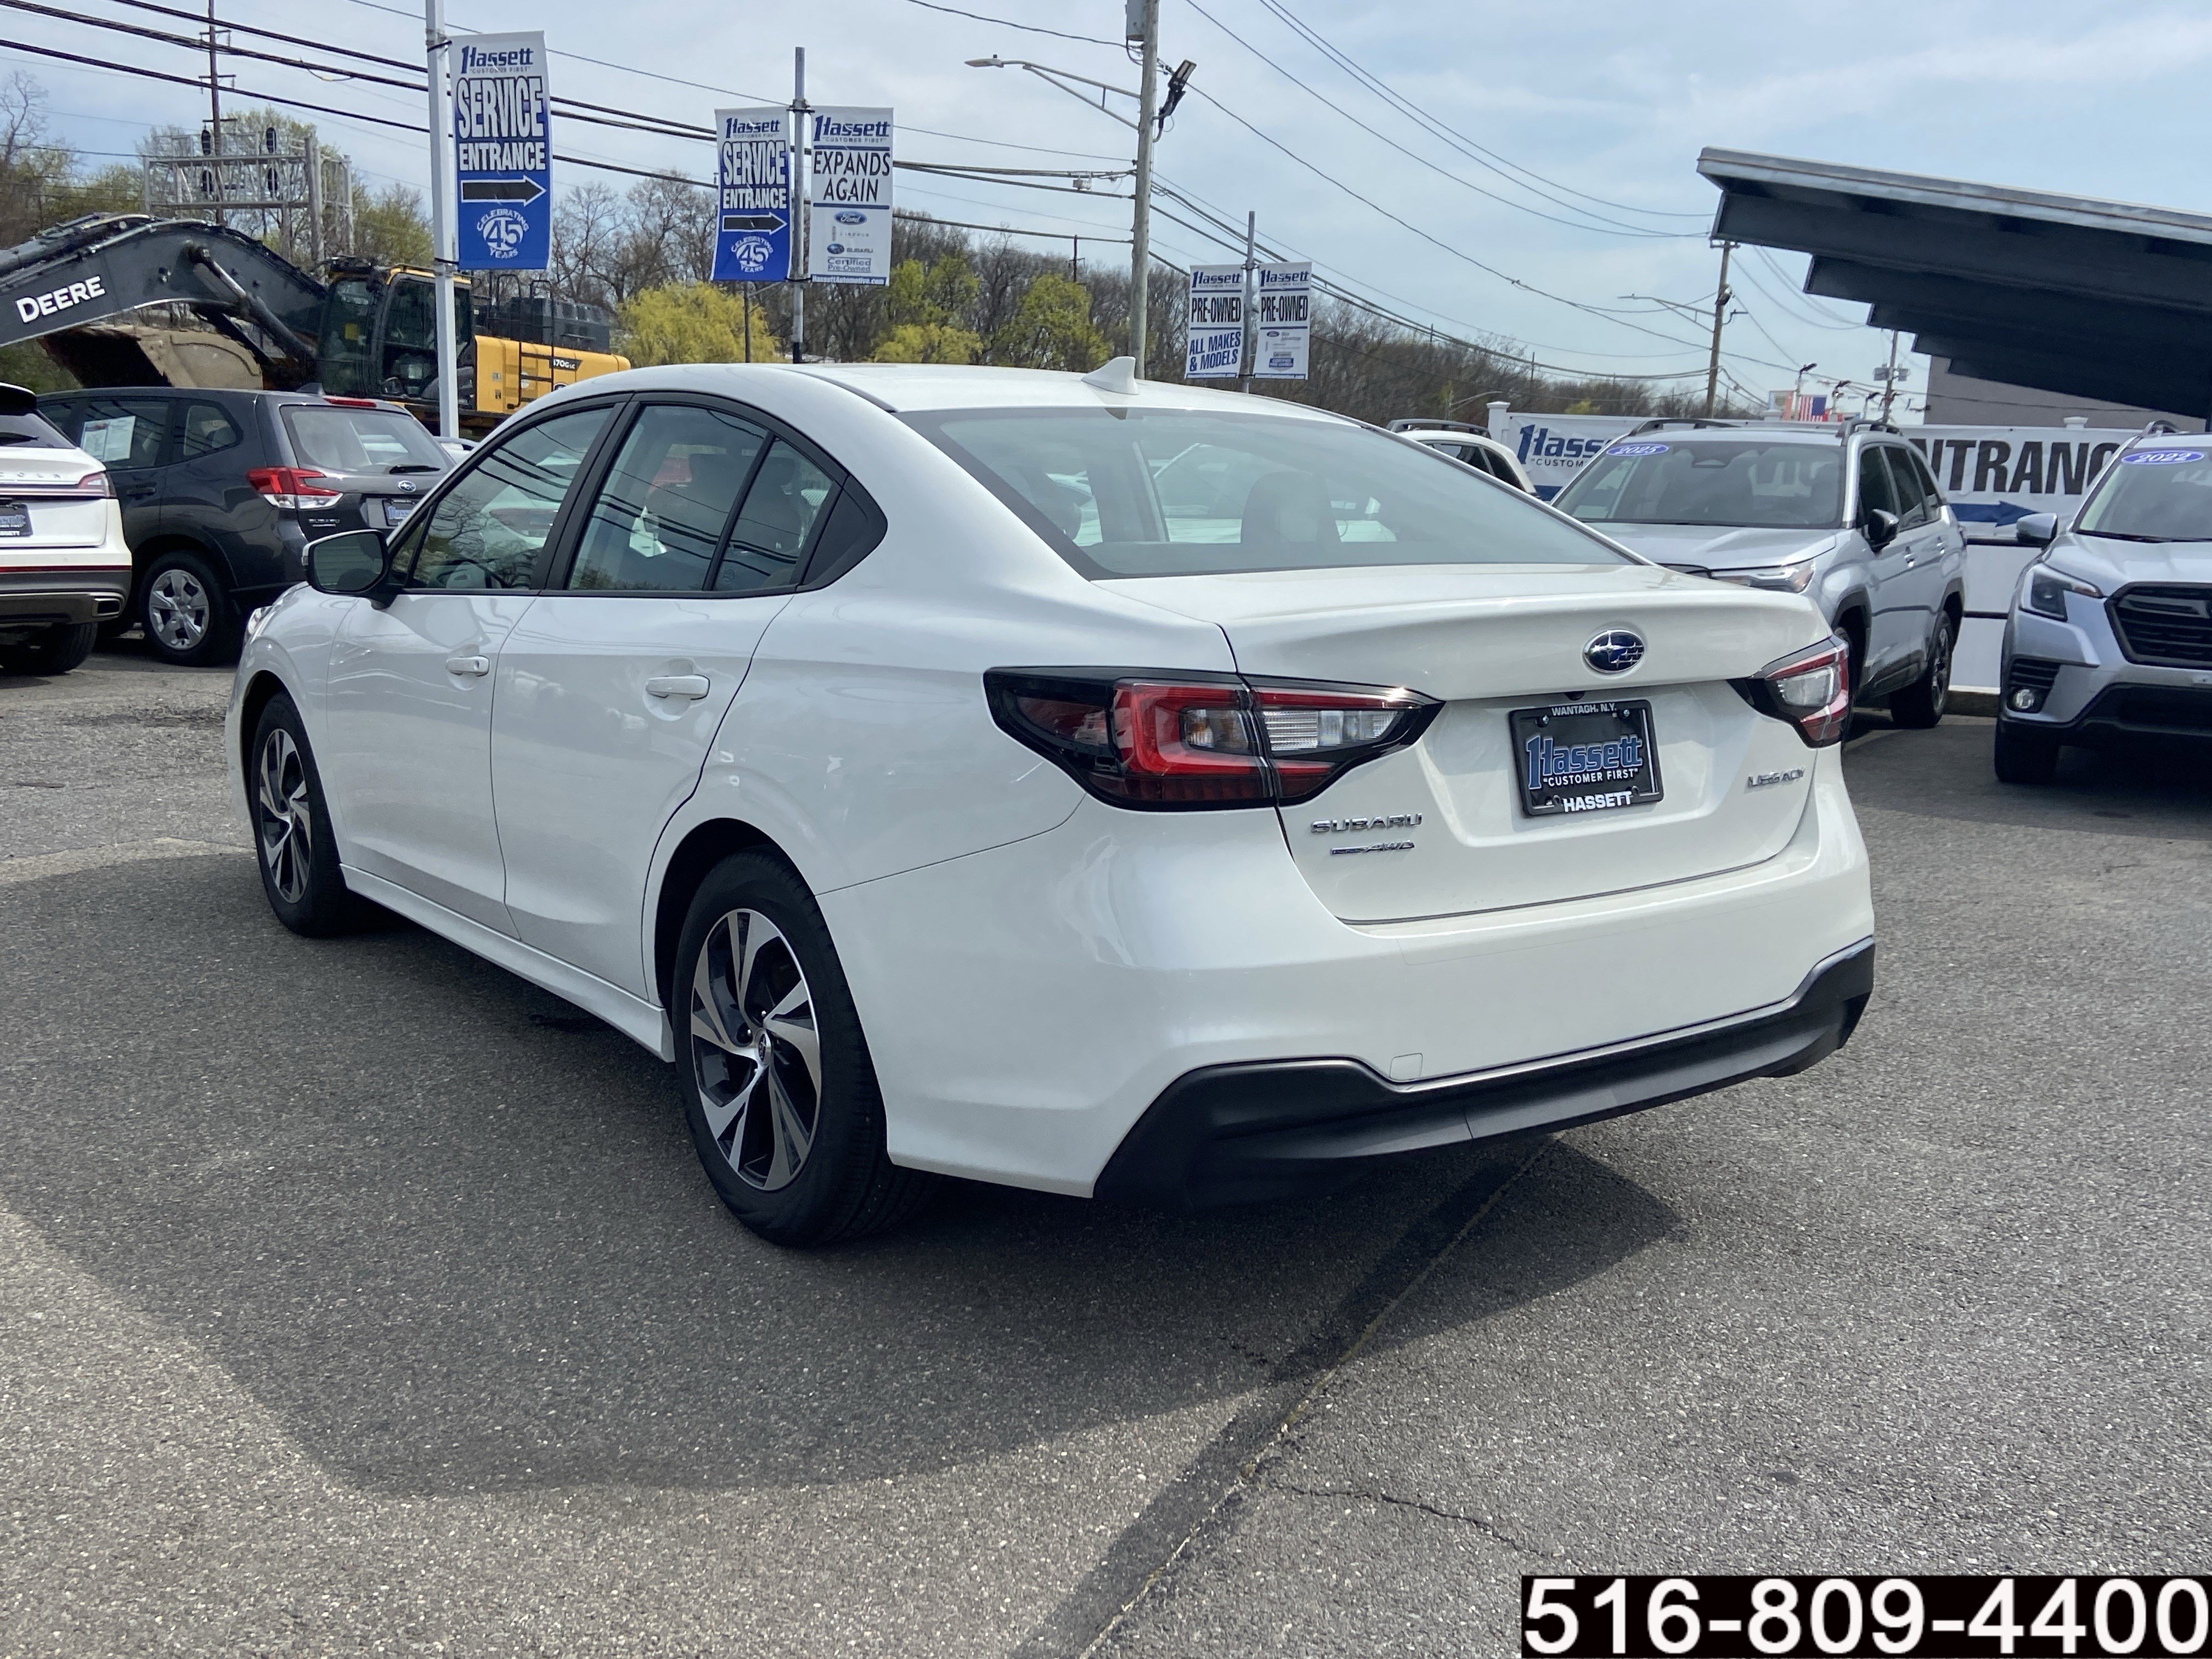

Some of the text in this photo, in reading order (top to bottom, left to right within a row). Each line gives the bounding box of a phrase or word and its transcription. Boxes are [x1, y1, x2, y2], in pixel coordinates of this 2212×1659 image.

[461, 45, 534, 74] Hassett
[456, 76, 545, 139] SERVICE
[725, 117, 780, 139] Hassett
[814, 115, 891, 142] Hassett
[459, 140, 546, 172] ENTRANCE
[723, 140, 787, 185] SERVICE
[814, 151, 891, 176] EXPANDS
[722, 188, 787, 210] ENTRANCE
[823, 177, 879, 202] AGAIN
[477, 208, 529, 232] CELEBRATING
[485, 218, 522, 250] 45
[489, 248, 518, 259] YEARS
[737, 243, 768, 265] 45
[741, 262, 764, 273] YEARS
[1192, 271, 1242, 288] Hassett
[1260, 269, 1310, 287] Hassett
[15, 275, 105, 323] DEERE
[1191, 297, 1242, 323] PRE-OWNED
[1261, 295, 1308, 322] PRE-OWNED
[1189, 331, 1241, 356] ALL MAKES
[1189, 349, 1239, 371] & MODELS
[1615, 445, 1660, 455] 2025
[2133, 453, 2193, 463] 2022
[1600, 703, 1617, 712] N.Y.
[1527, 733, 1643, 789] Hassett
[1563, 791, 1634, 812] HASSETT
[1311, 812, 1423, 834] SUBARU
